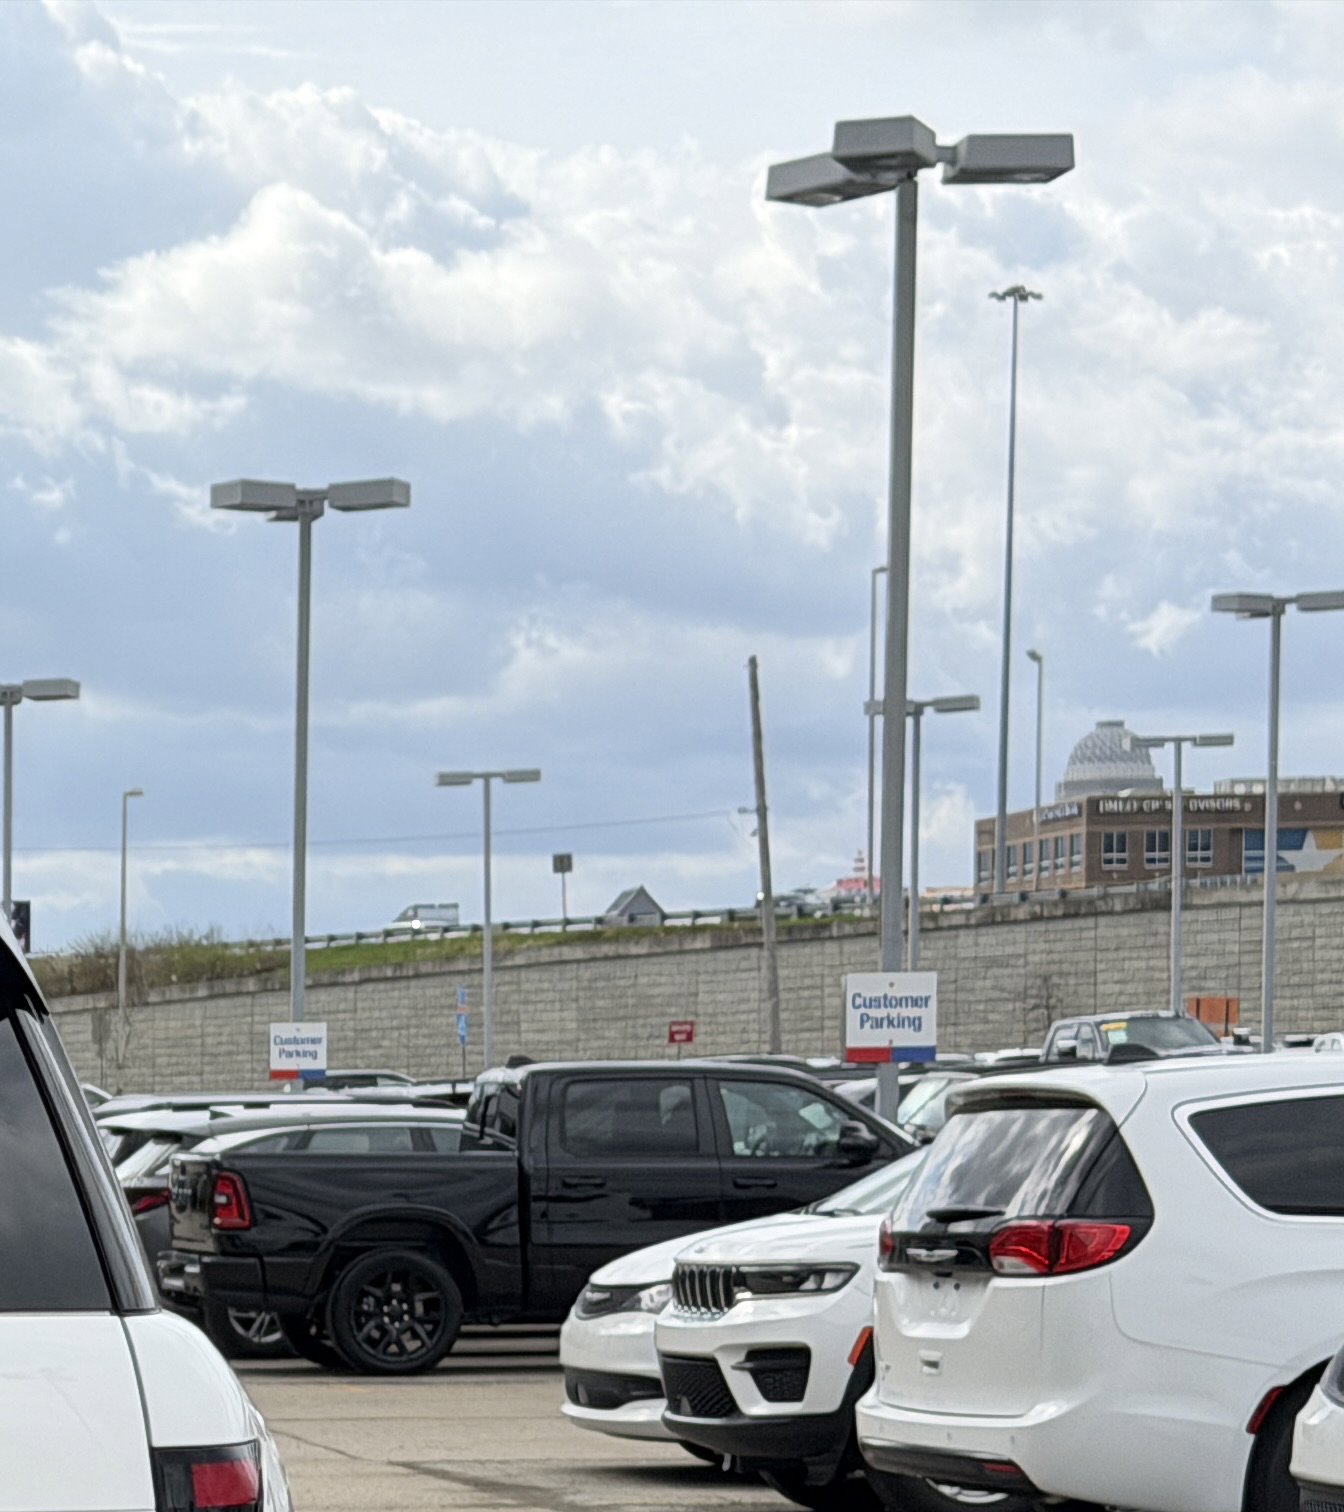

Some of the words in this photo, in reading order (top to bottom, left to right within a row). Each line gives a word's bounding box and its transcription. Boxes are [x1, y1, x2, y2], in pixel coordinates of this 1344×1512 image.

[852, 992, 931, 1010] Customer
[859, 1012, 922, 1033] Parking
[274, 1035, 322, 1046] Customer
[278, 1047, 318, 1060] Parking
